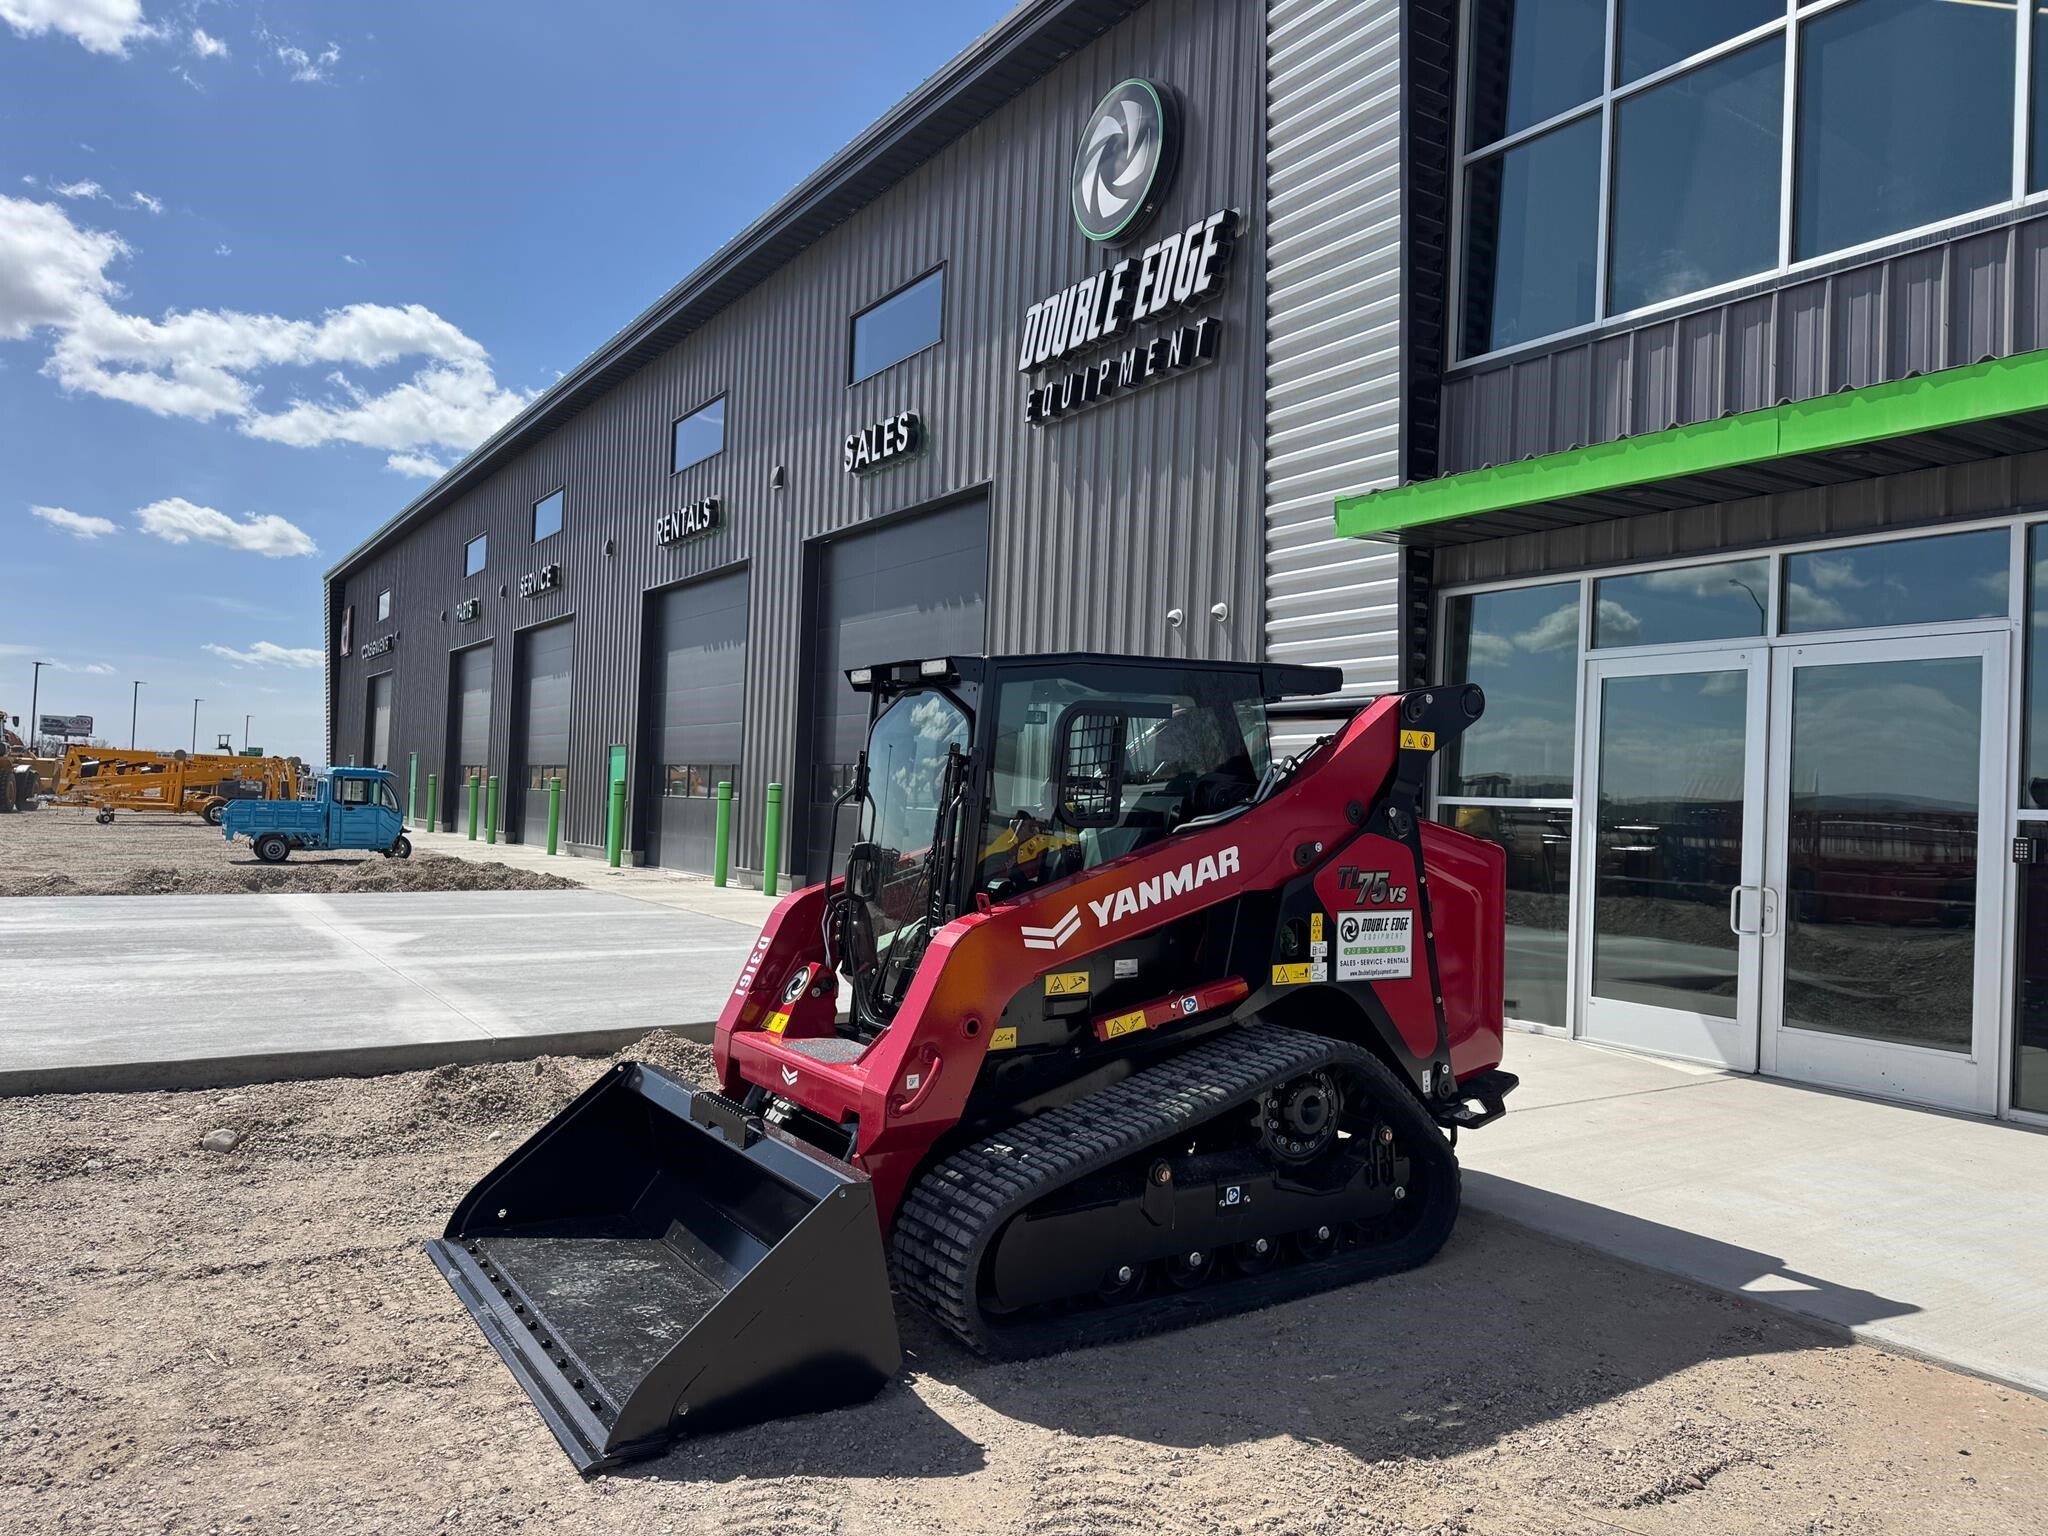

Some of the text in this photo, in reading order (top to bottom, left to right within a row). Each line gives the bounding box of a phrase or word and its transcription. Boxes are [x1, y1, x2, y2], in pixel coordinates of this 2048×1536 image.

[1018, 209, 1227, 373] DOUBLE EDGE
[1025, 318, 1210, 423] EQUIPMENT
[844, 411, 909, 473] SALES
[656, 498, 711, 546] RENTALS
[520, 565, 552, 598] SERVICE
[1088, 846, 1240, 927] YANMAR
[1361, 917, 1410, 932] DOUBLE EDGE
[735, 936, 771, 996] D3161
[1340, 957, 1409, 967] SALES SERVICE RENTALS
